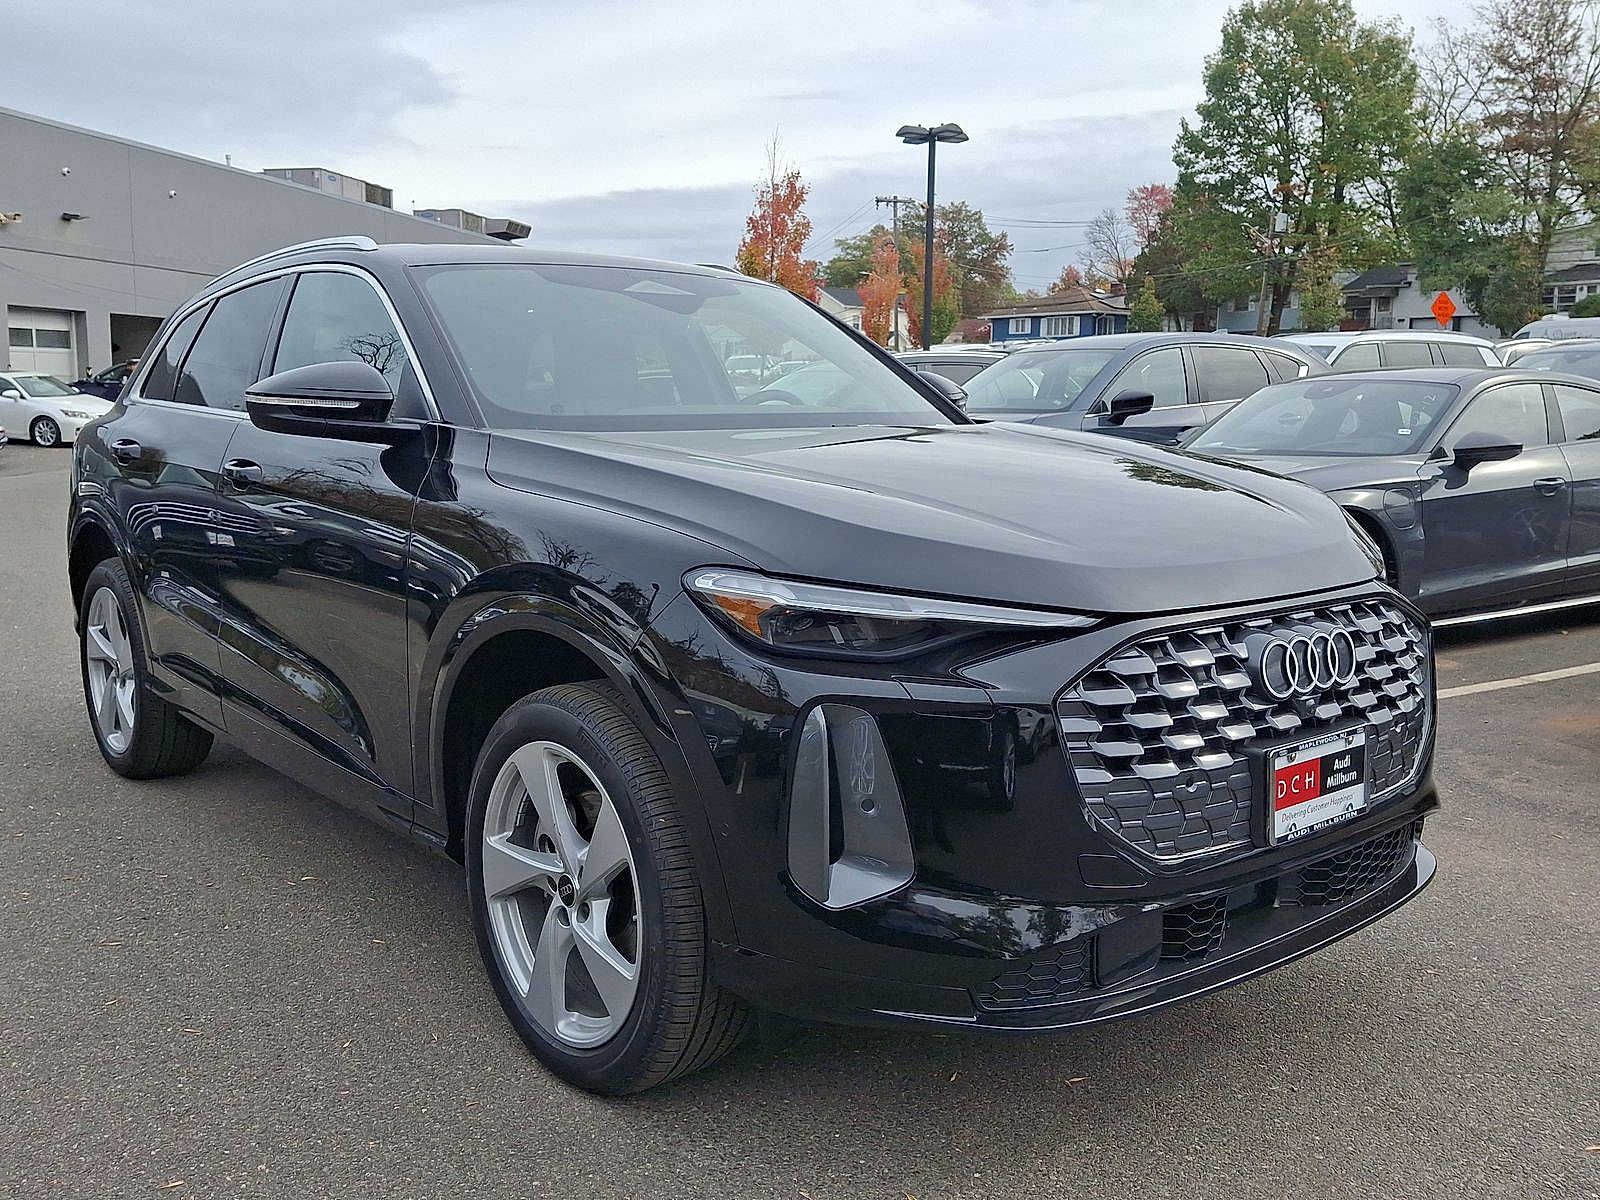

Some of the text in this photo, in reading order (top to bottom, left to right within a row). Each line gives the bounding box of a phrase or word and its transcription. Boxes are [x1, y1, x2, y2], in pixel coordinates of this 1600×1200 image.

[1333, 754, 1351, 771] Audi
[1326, 770, 1357, 789] Millburn
[1281, 793, 1354, 823] Delivering Customer Happiness
[1287, 810, 1358, 841] AUDI MILLBURN
